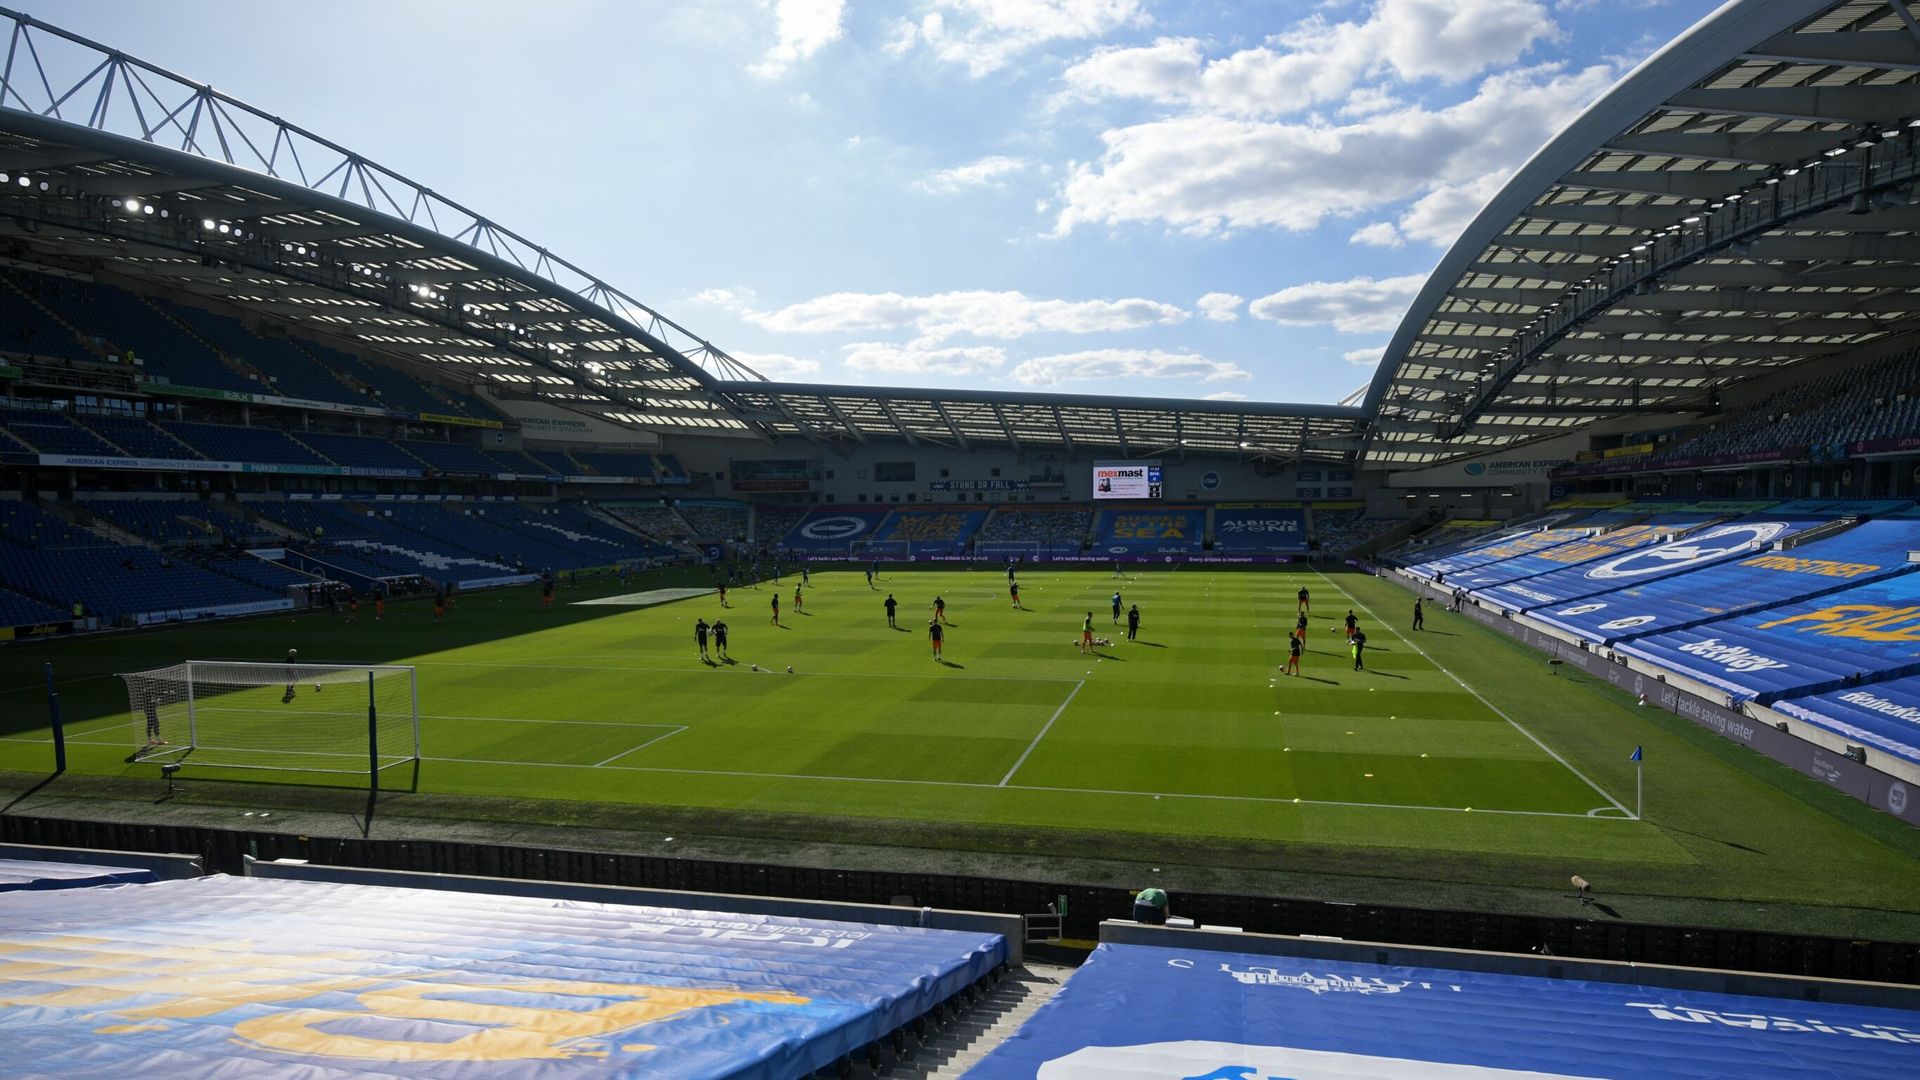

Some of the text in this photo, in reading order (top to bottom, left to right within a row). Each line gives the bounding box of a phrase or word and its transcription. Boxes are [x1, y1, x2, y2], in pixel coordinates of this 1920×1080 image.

[66, 457, 105, 466] AMERICAN
[106, 459, 139, 467] EXPRESS
[140, 460, 185, 468] COMMUNITY
[1489, 460, 1530, 468] AMERICAN
[1097, 469, 1144, 477] mexmast
[1488, 468, 1537, 476] COMMUNITY
[950, 481, 1010, 489] STAND OR FALL
[1112, 528, 1185, 538] SEA
[1678, 638, 1789, 673] betway
[1661, 688, 1754, 741] Let's tackle saving water
